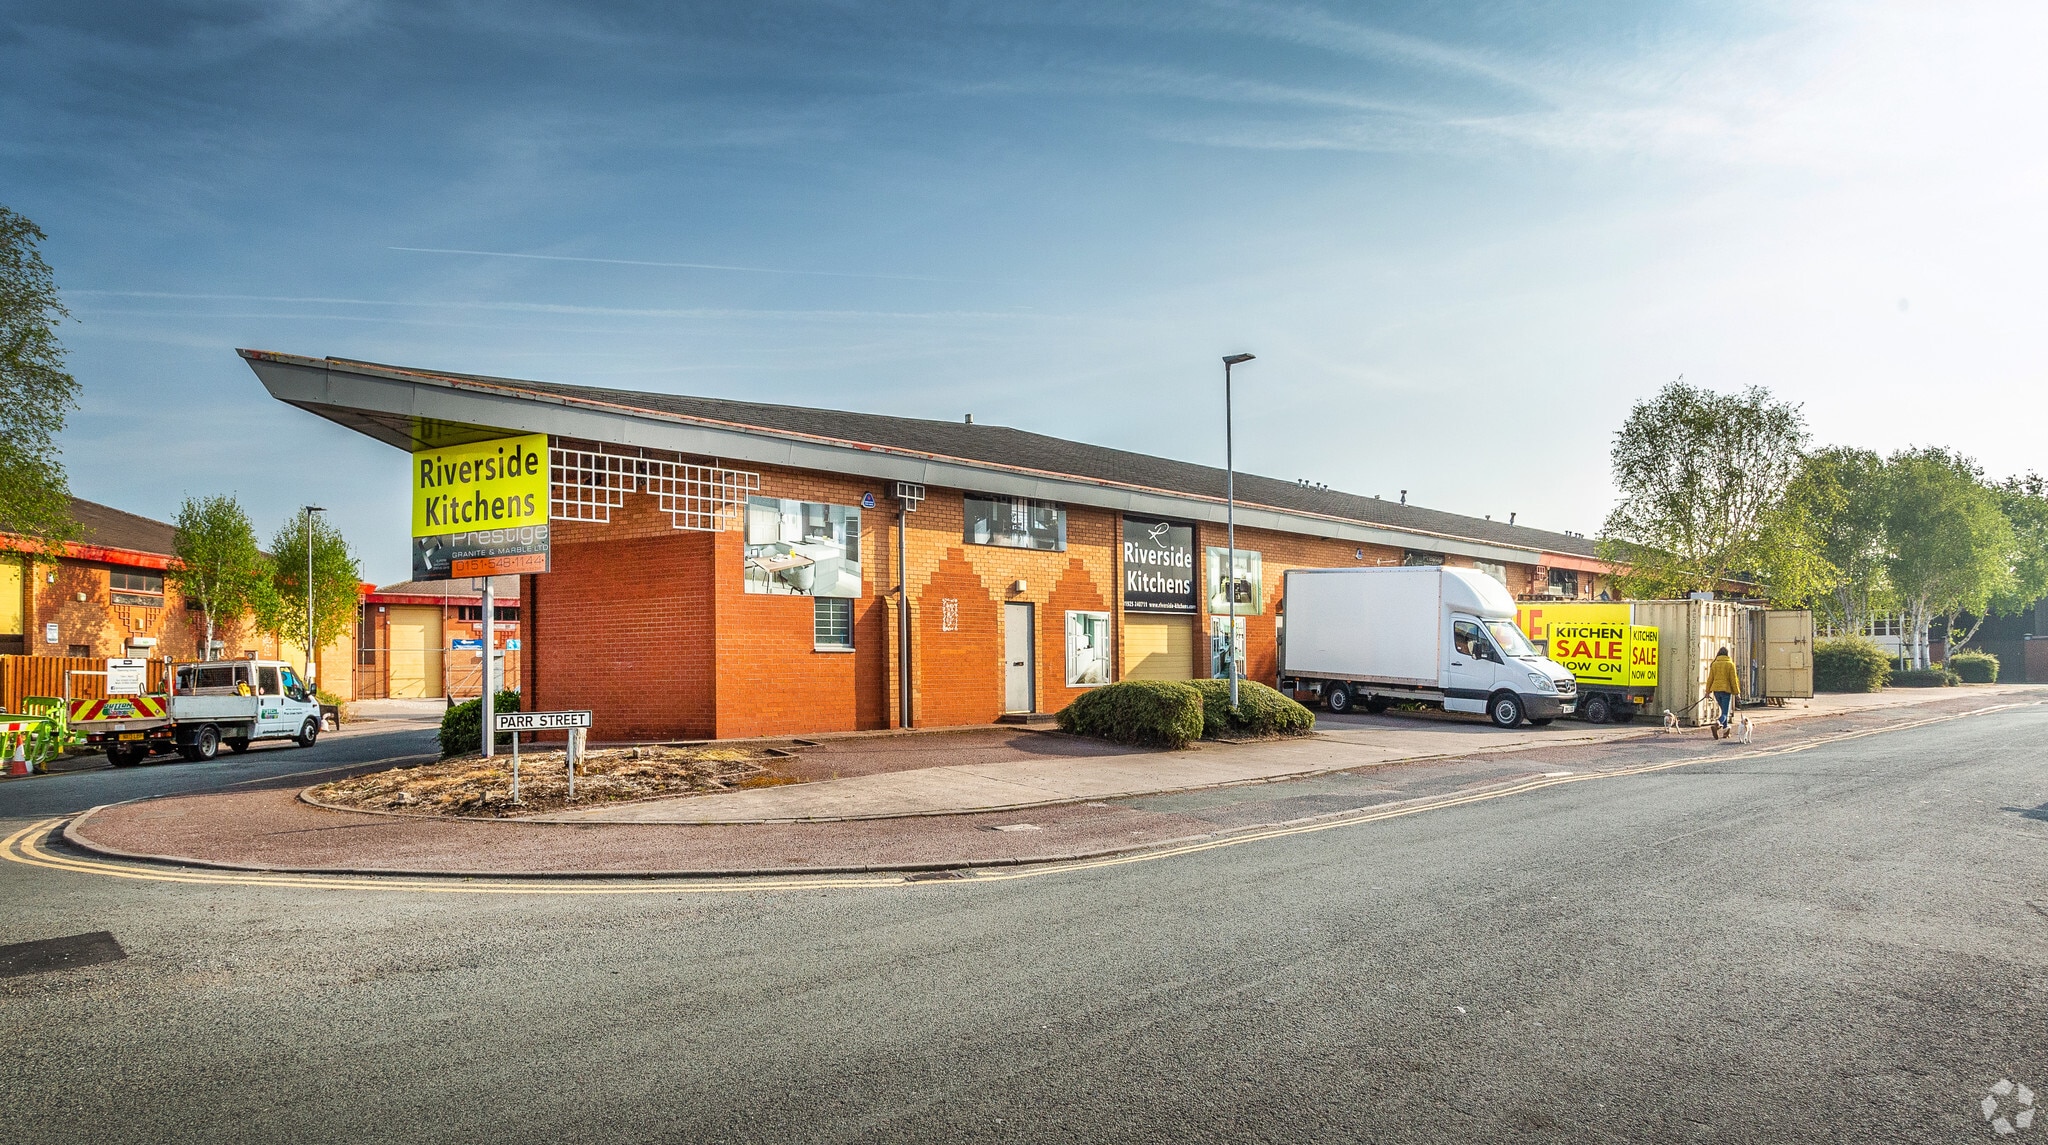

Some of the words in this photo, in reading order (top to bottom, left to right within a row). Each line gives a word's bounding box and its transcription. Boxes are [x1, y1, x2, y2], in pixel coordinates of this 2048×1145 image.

[421, 444, 538, 488] Riverside
[426, 490, 535, 526] Kitchens
[452, 525, 548, 547] Prestige
[452, 549, 486, 559] GRANITE
[498, 546, 532, 555] MARBLE
[534, 544, 549, 552] LTD
[1124, 542, 1192, 568] Riverside
[1127, 570, 1190, 595] Kitchens
[1556, 628, 1623, 639] KITCHEN
[1633, 631, 1657, 642] KITCHEN
[1556, 640, 1622, 660] SALE
[1633, 647, 1656, 665] SALE
[1598, 663, 1622, 672] ON
[1631, 671, 1645, 680] NOW
[1647, 671, 1656, 680] ON
[501, 715, 533, 728] PARR
[540, 714, 585, 726] STREET
